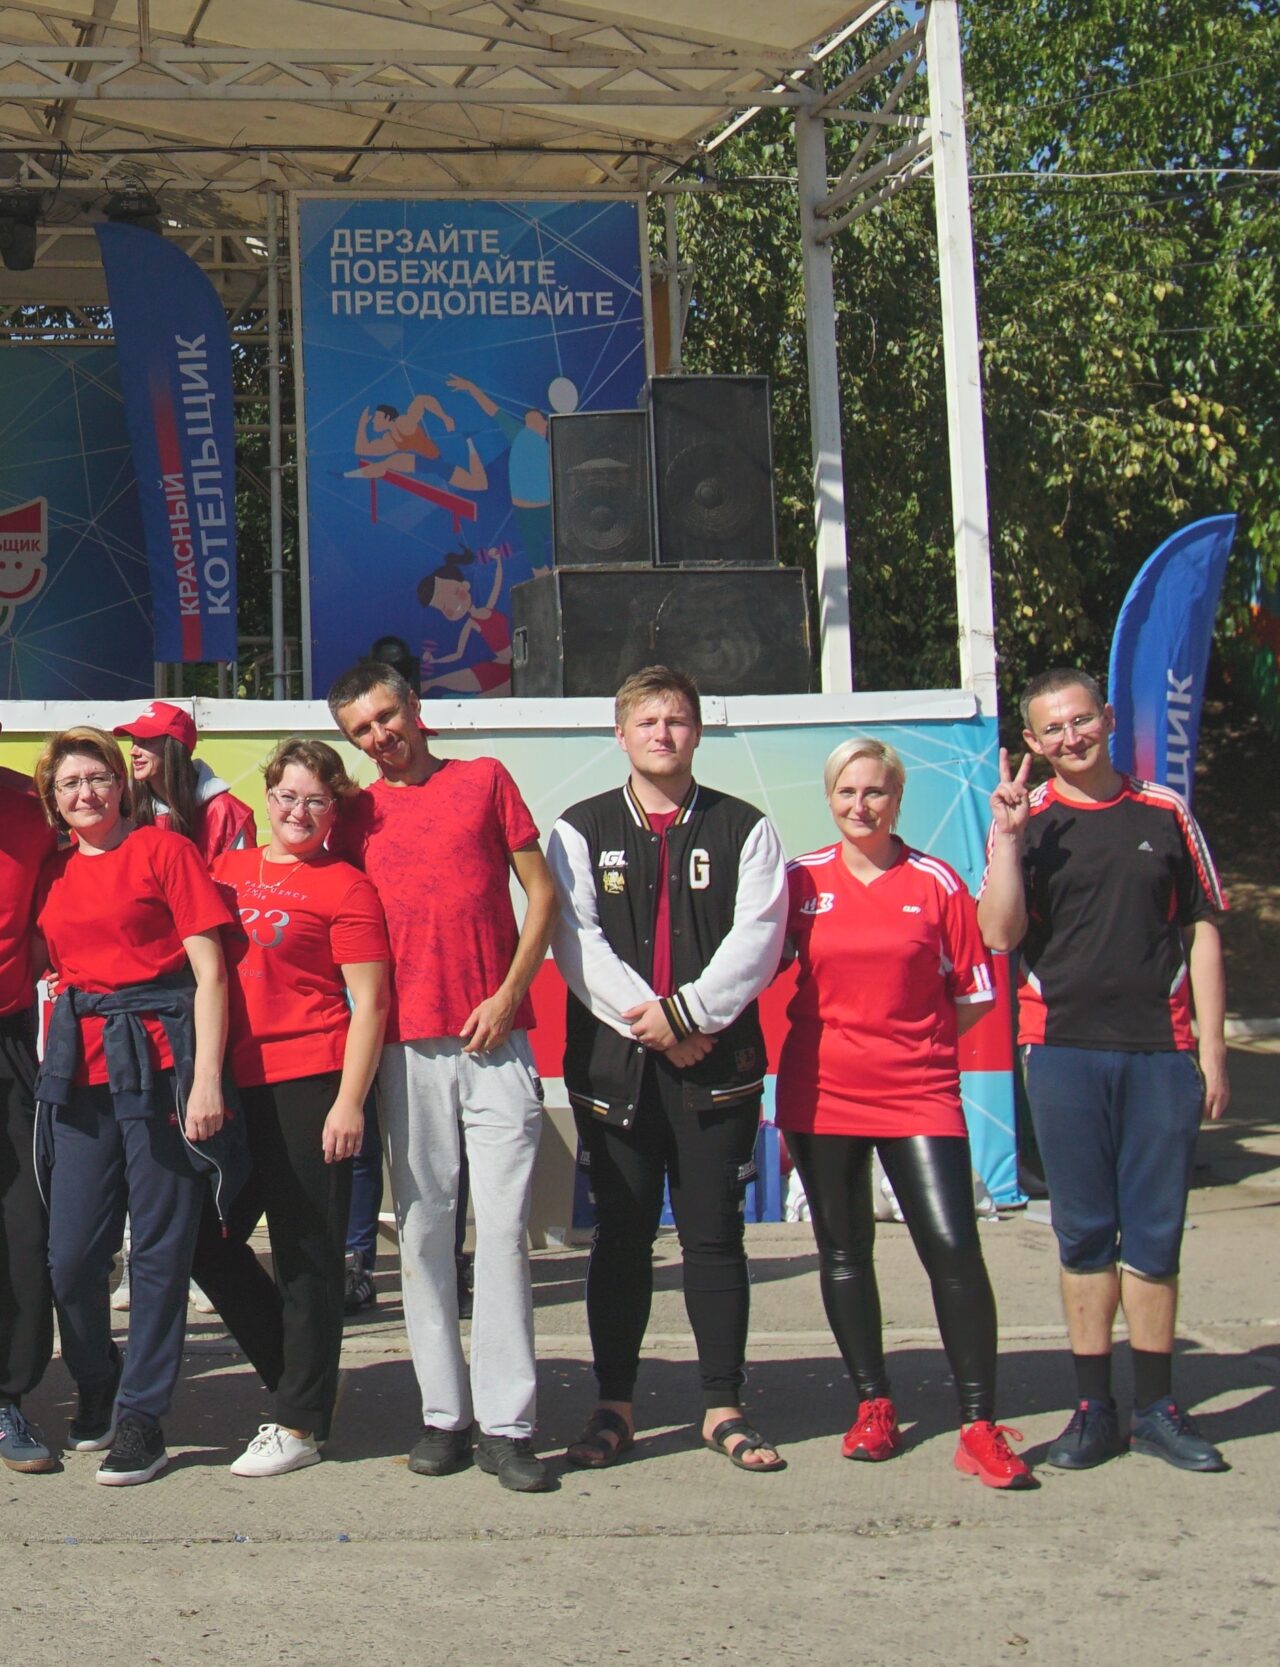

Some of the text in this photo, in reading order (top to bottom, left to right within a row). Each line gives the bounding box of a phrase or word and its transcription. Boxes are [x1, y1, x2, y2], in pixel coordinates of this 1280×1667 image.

[331, 223, 500, 256] ДЕРЗАЙТЕ
[331, 255, 556, 288] ПОБЕЖДАЙТЕ
[331, 284, 616, 319] ПРЕОДОЛЕВАЙТЕ
[175, 333, 231, 616] КОТЕЛЬЩИК
[157, 472, 201, 616] КРАСНЫЙ
[689, 848, 711, 890] G
